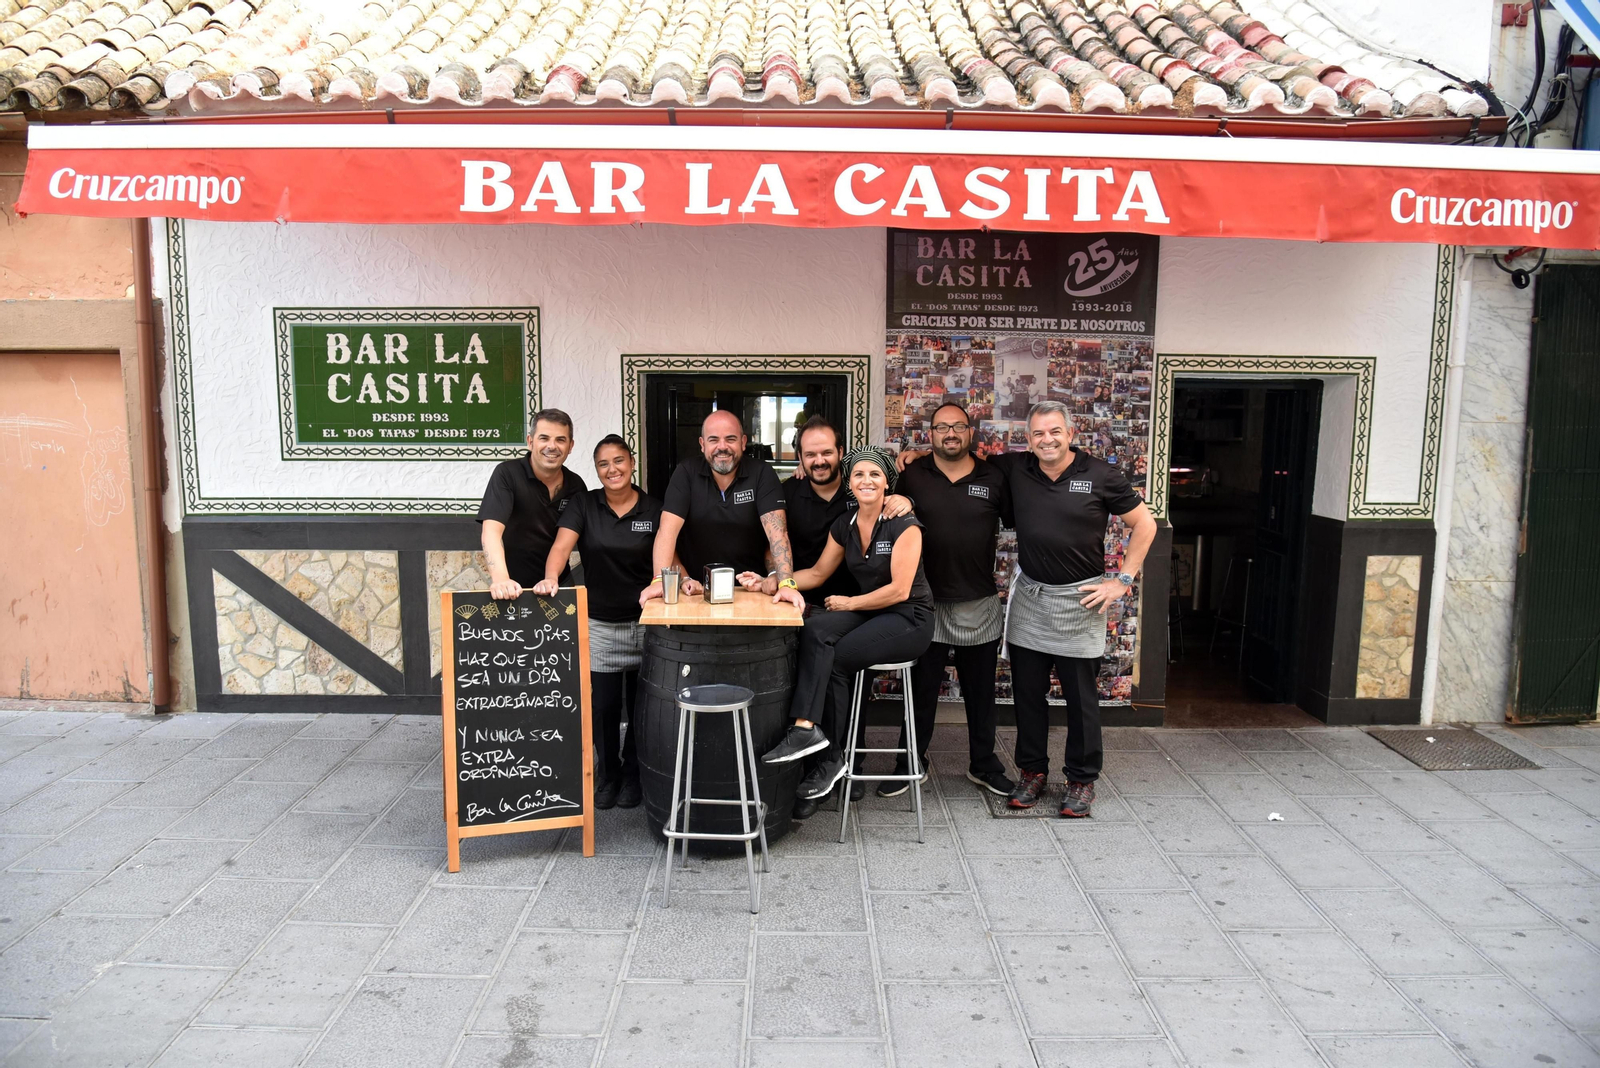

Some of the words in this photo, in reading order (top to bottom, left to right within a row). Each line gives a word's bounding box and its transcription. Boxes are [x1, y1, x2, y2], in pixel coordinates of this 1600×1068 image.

[49, 167, 244, 209] Cruzcampo
[460, 160, 645, 213] BAR
[685, 163, 800, 217] LA
[834, 164, 1170, 225] CASITA
[916, 236, 976, 259] BAR
[994, 239, 1032, 261] LA
[1068, 238, 1115, 285] 25
[1116, 247, 1139, 256] Años
[916, 264, 1033, 288] CASITA
[1100, 269, 1132, 293] ANIVERSARIO
[981, 293, 1003, 301] 1993
[984, 304, 1016, 312] DESDE
[1018, 305, 1039, 313] 1973
[1072, 303, 1132, 313] 1993-2018
[901, 315, 957, 328] GRACIAS
[959, 316, 987, 328] POR
[989, 317, 1015, 329] SER
[1016, 318, 1058, 330] PARTE
[1060, 319, 1078, 330] DE
[1080, 320, 1146, 333] NOSOTROS
[326, 333, 409, 365] BAR
[434, 333, 489, 365] LA
[327, 373, 490, 404] CASITA
[372, 413, 415, 423] DESDE
[420, 413, 450, 423] 1993
[322, 428, 339, 438] EL
[424, 428, 468, 438] DESDE
[472, 428, 501, 438] 1973
[458, 622, 525, 642] BUENOS
[458, 651, 490, 667] HAZ
[492, 652, 529, 667] QUE
[533, 652, 572, 671] HOY
[457, 670, 491, 688] SEA
[498, 671, 521, 684] UN
[458, 726, 468, 749] Y
[475, 728, 525, 743] NUNCA
[529, 729, 564, 741] SEA
